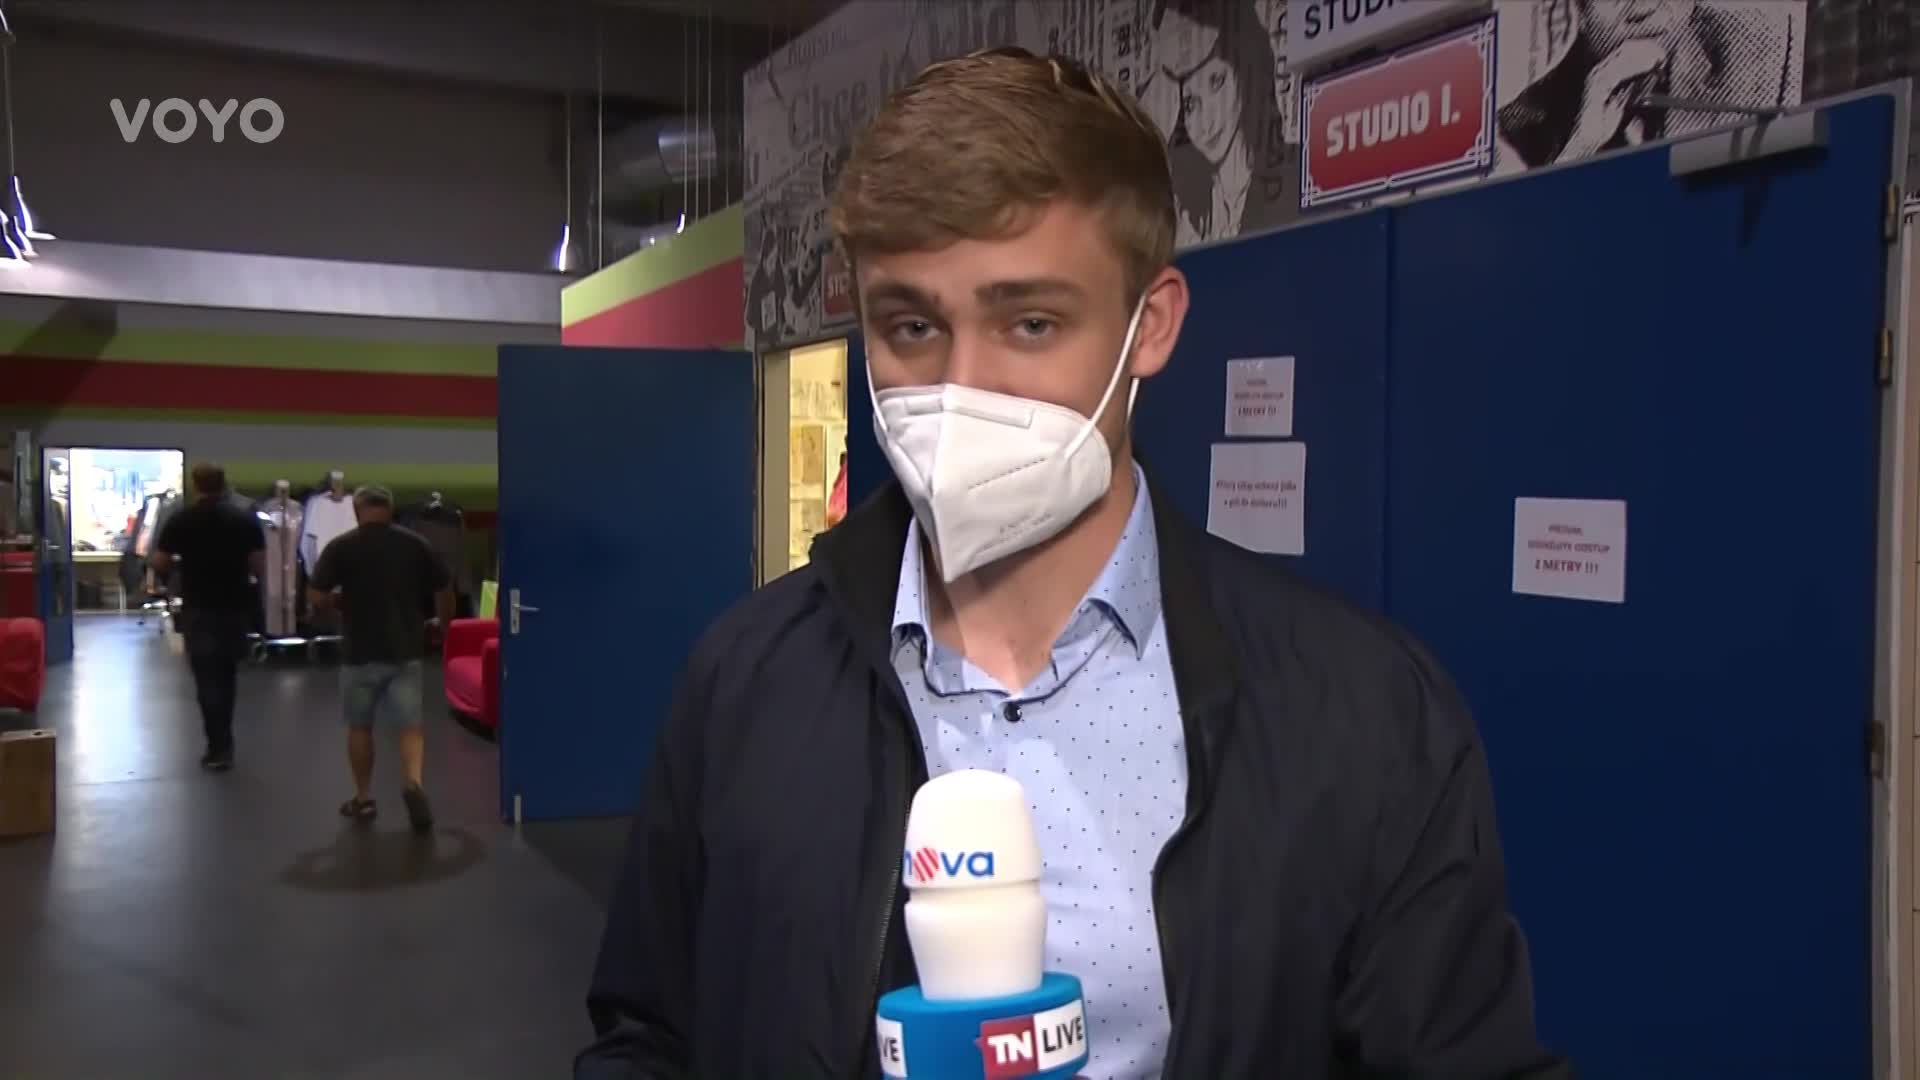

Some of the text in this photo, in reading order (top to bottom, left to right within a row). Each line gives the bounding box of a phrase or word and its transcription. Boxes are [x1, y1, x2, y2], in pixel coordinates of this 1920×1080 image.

[1304, 0, 1409, 39] STUD
[1326, 90, 1430, 158] STUDIO
[1543, 560, 1582, 573] METRY
[987, 1016, 1083, 1064] TN LIVE
